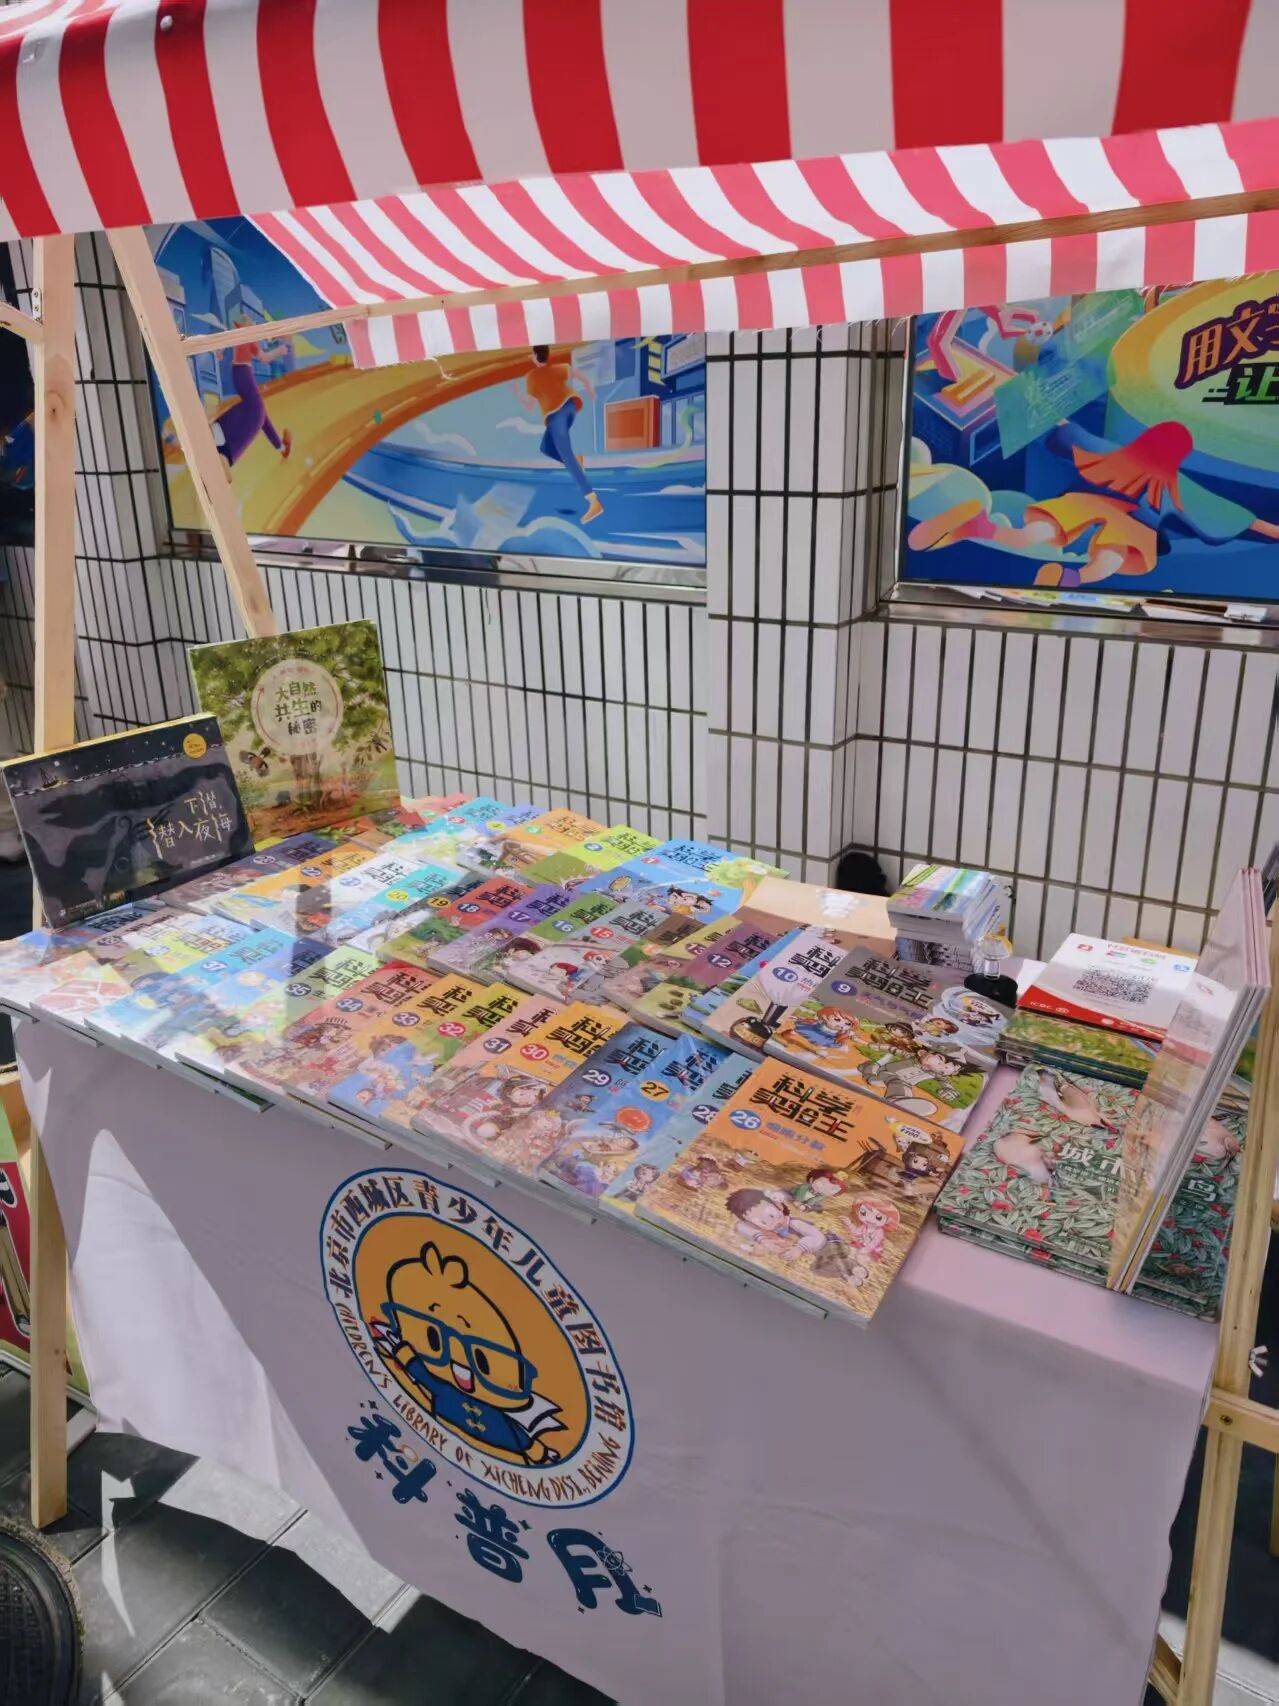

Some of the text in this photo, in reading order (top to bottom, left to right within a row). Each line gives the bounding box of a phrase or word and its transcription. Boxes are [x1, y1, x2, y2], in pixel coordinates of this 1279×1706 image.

[274, 680, 320, 702] 大自然
[274, 698, 322, 722] 共生的
[288, 718, 318, 736] 秘密
[430, 897, 449, 907] 19
[460, 904, 479, 913] 18
[510, 911, 529, 922] 17
[554, 920, 573, 932] 16
[592, 926, 613, 938] 15
[711, 953, 733, 967] 12
[776, 968, 798, 982] 10
[285, 984, 311, 996] 35
[338, 998, 363, 1011] 34
[394, 1012, 420, 1026] 33
[439, 1023, 465, 1036] 32
[483, 1038, 510, 1052] 31
[521, 1043, 548, 1059] 30
[582, 1069, 610, 1086] 29
[641, 1081, 669, 1097] 27
[730, 1110, 761, 1130] 26
[393, 1394, 448, 1450] LIBRARY
[455, 1446, 474, 1468] OF
[480, 1460, 551, 1501] XICHENG
